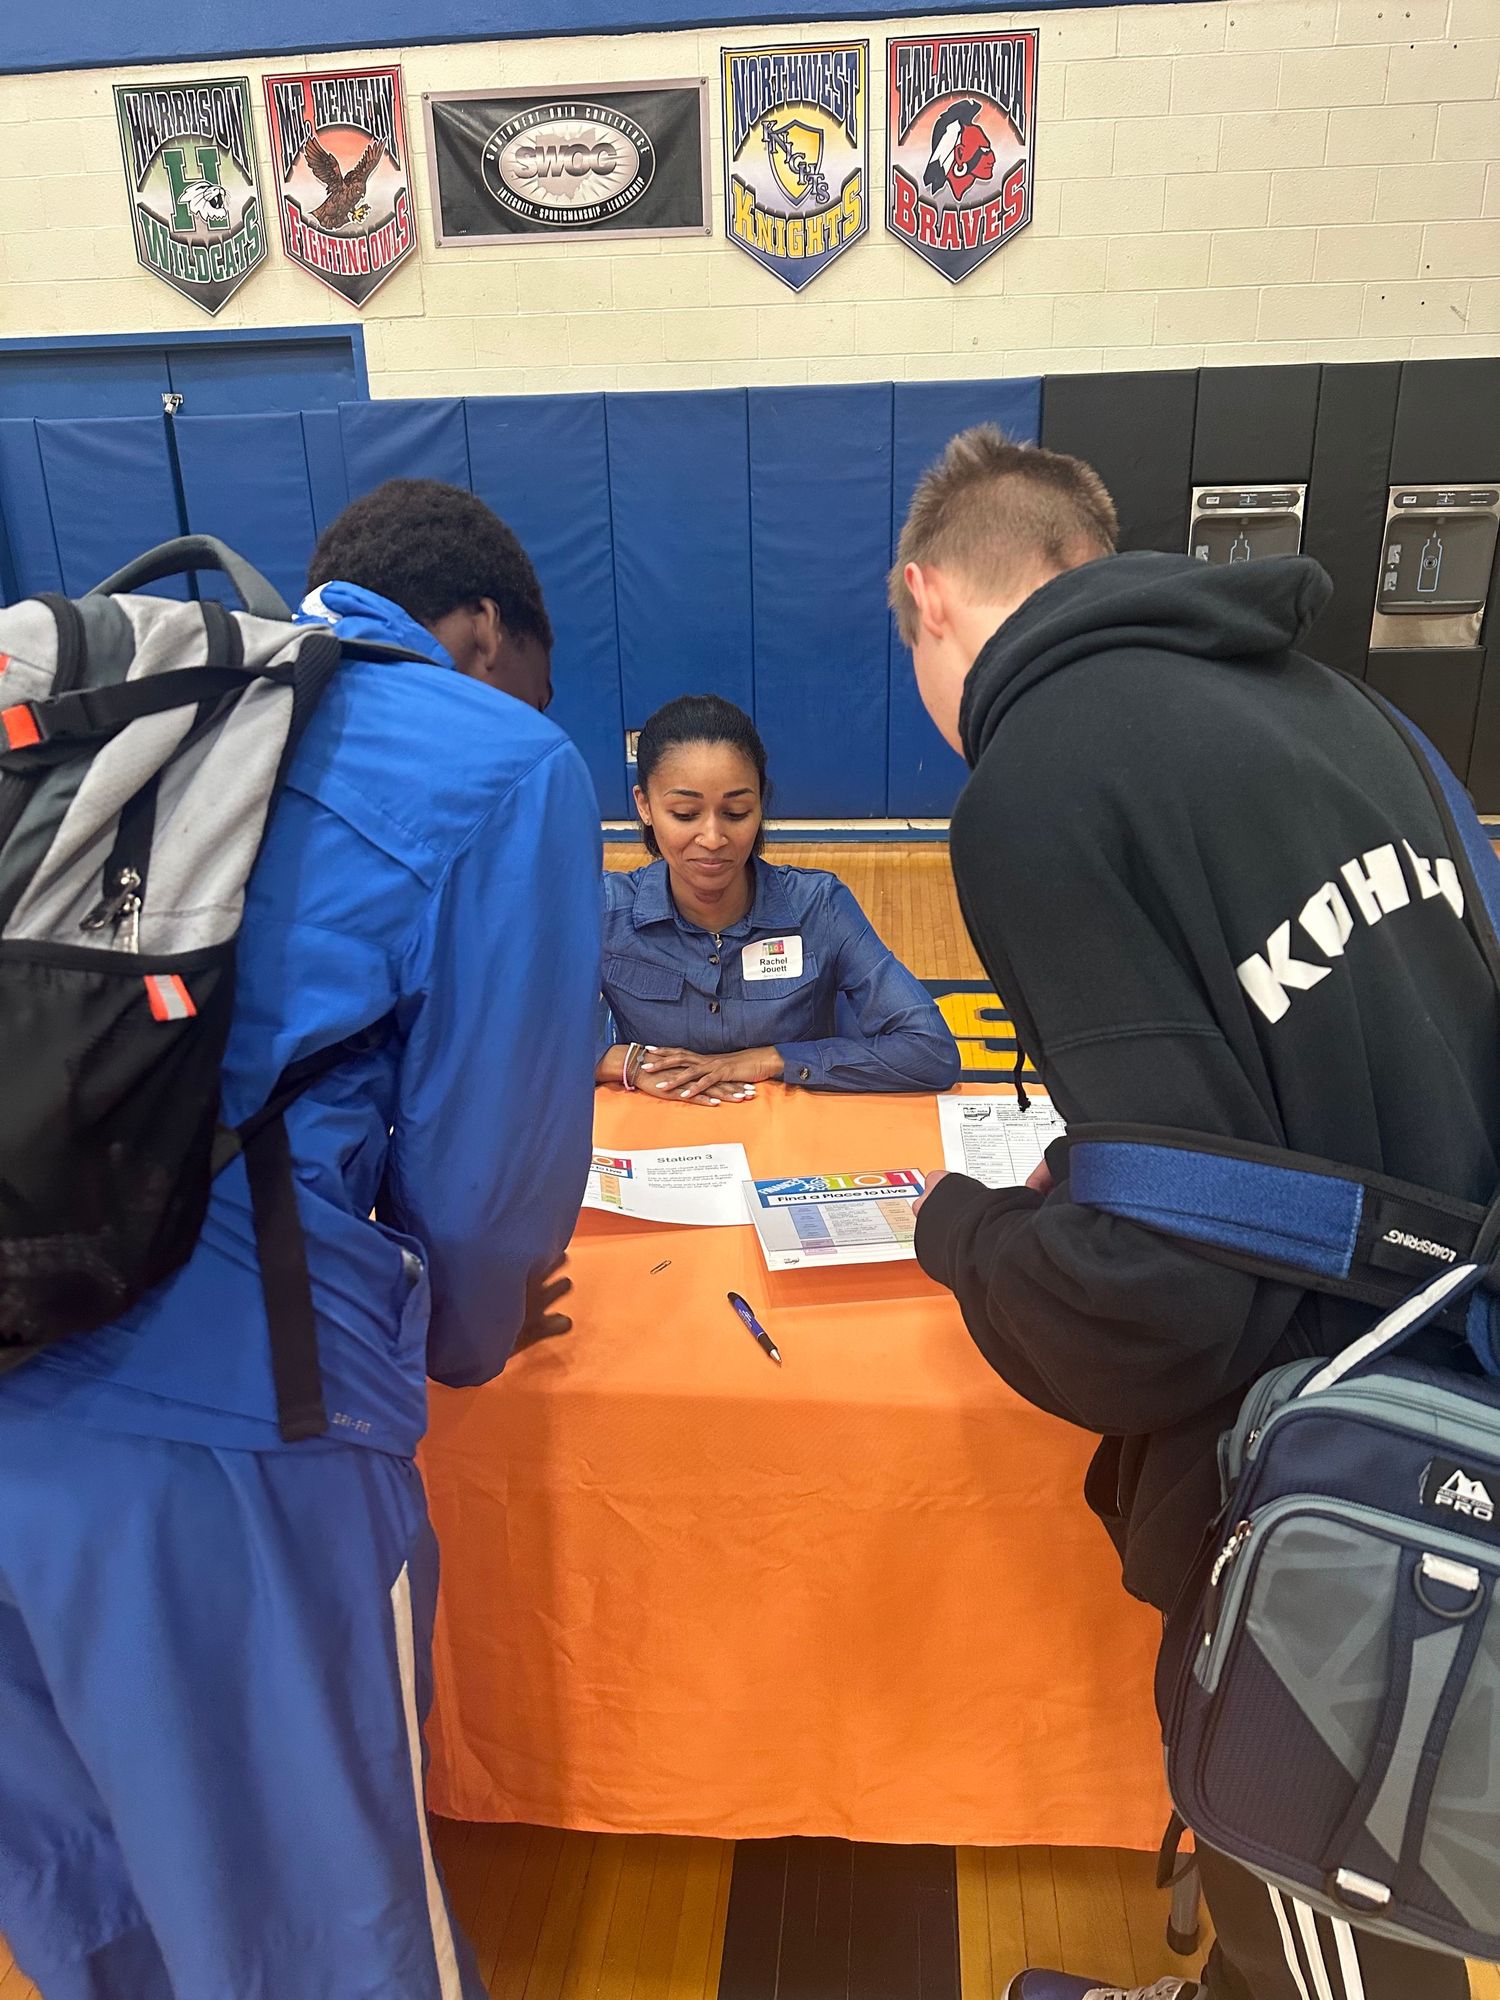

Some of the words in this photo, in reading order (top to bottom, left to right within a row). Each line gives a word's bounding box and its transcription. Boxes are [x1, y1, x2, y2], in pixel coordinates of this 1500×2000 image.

[731, 52, 859, 162] NORTHWEST
[897, 40, 1026, 146] TALAWANDA
[124, 86, 253, 192] HARRISON
[273, 82, 315, 182] MT.
[311, 76, 400, 172] HEALTHY
[486, 112, 541, 160] SOUTHWEST
[549, 106, 577, 119] OHIO
[585, 107, 650, 154] CONFERENCE
[513, 142, 617, 179] SWOC
[761, 120, 830, 204] KNIGHTS
[162, 145, 231, 233] H
[497, 186, 534, 215] INTEGRITY
[539, 205, 601, 221] SPORTSMANSHIP
[606, 176, 645, 212] LEADERSHIP
[732, 176, 862, 259] KNIGHTS
[893, 169, 1026, 250] BRAVES
[140, 200, 259, 284] WILDCATS
[287, 202, 369, 276] FIGHTING
[368, 195, 408, 271] OWLS
[760, 957, 788, 966] Rachel
[761, 965, 787, 973] Jouett
[657, 1155, 702, 1163] Station
[830, 1172, 909, 1190] 101
[777, 1194, 806, 1202] Find
[823, 1190, 861, 1199] Place
[881, 1187, 908, 1195] Live
[1387, 1229, 1457, 1263] LOADSPRING
[1434, 1493, 1493, 1521] PRO
